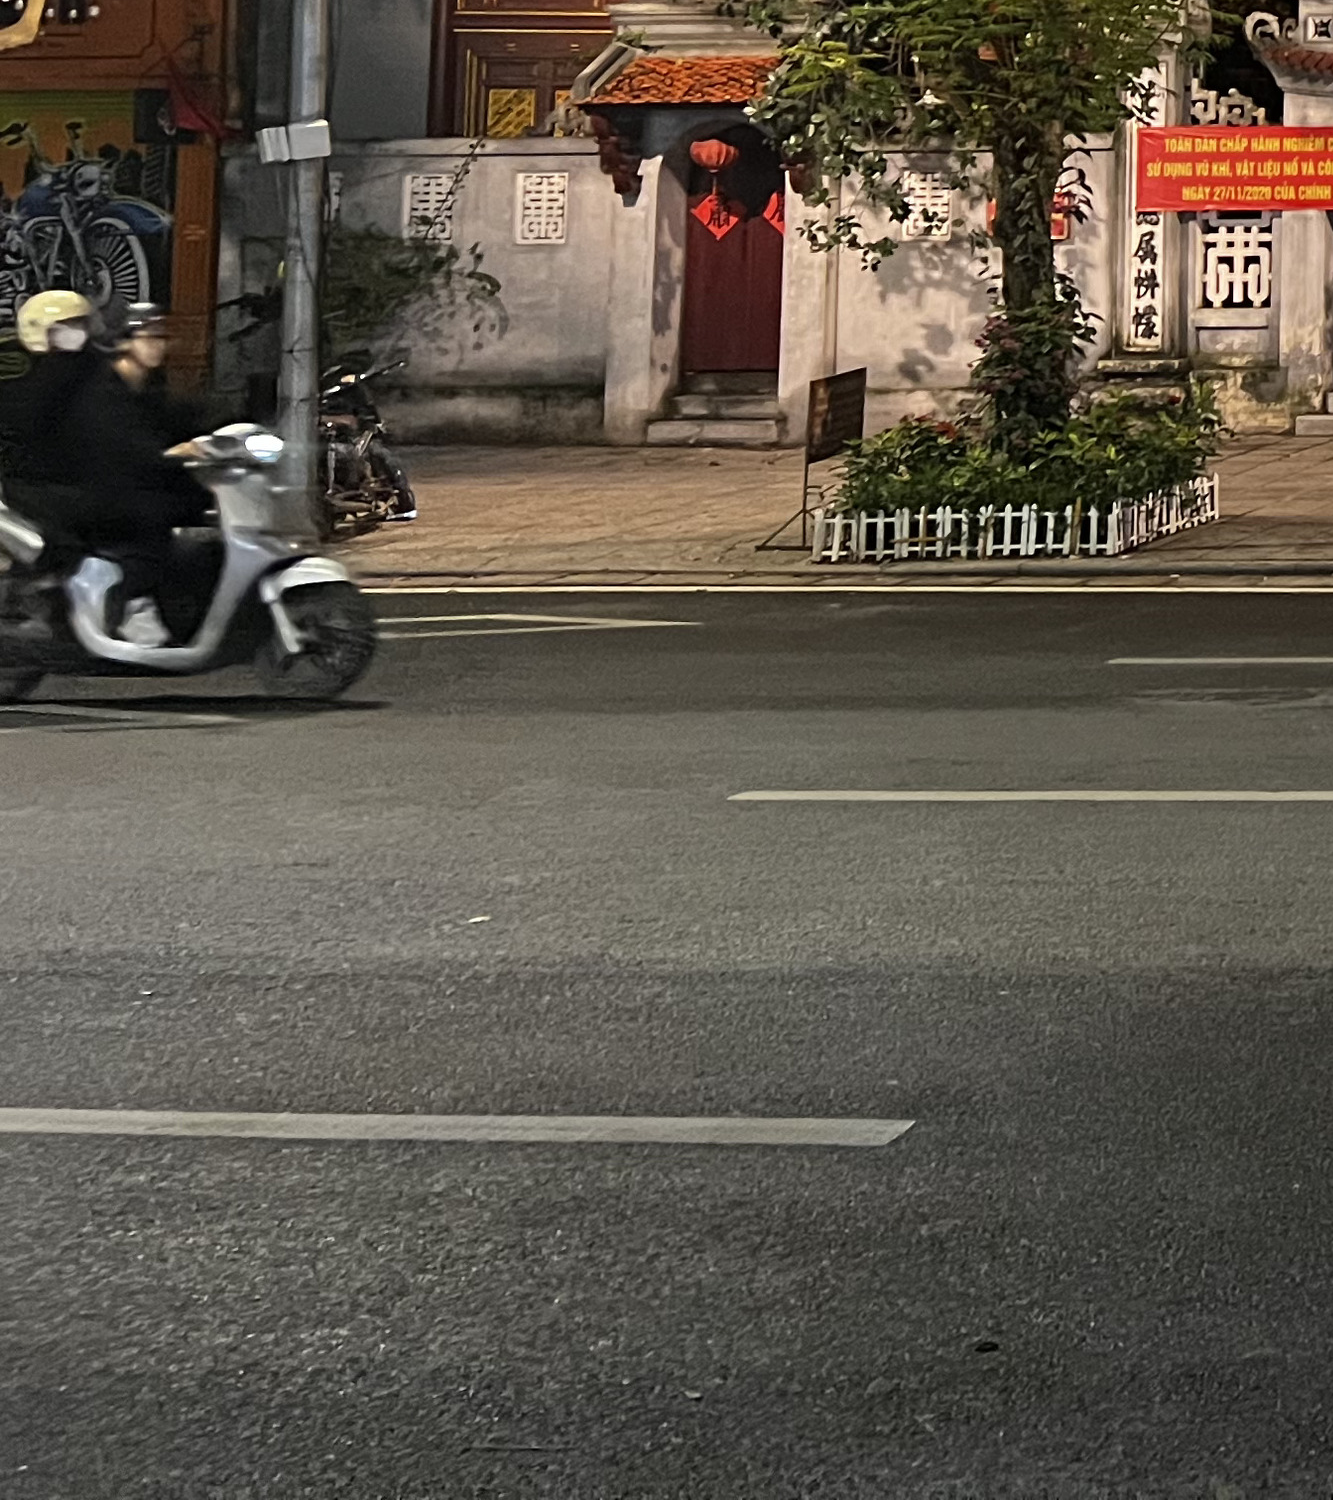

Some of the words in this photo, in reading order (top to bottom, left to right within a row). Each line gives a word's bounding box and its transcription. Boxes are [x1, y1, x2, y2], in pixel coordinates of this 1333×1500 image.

[1165, 135, 1192, 153] TOÀN
[1219, 132, 1249, 153] CHẤP
[1251, 134, 1281, 153] HÀNH
[1163, 162, 1193, 180] DỤNG
[1195, 159, 1210, 177] VŨ
[1235, 159, 1255, 179] VẬT
[1257, 159, 1280, 179] LIỆU
[1301, 159, 1316, 177] VÀ
[1182, 184, 1211, 201] NGÀY
[1213, 186, 1272, 201] 27/11/2020
[1274, 181, 1296, 201] CỦA
[1298, 183, 1331, 201] CHÍNH
